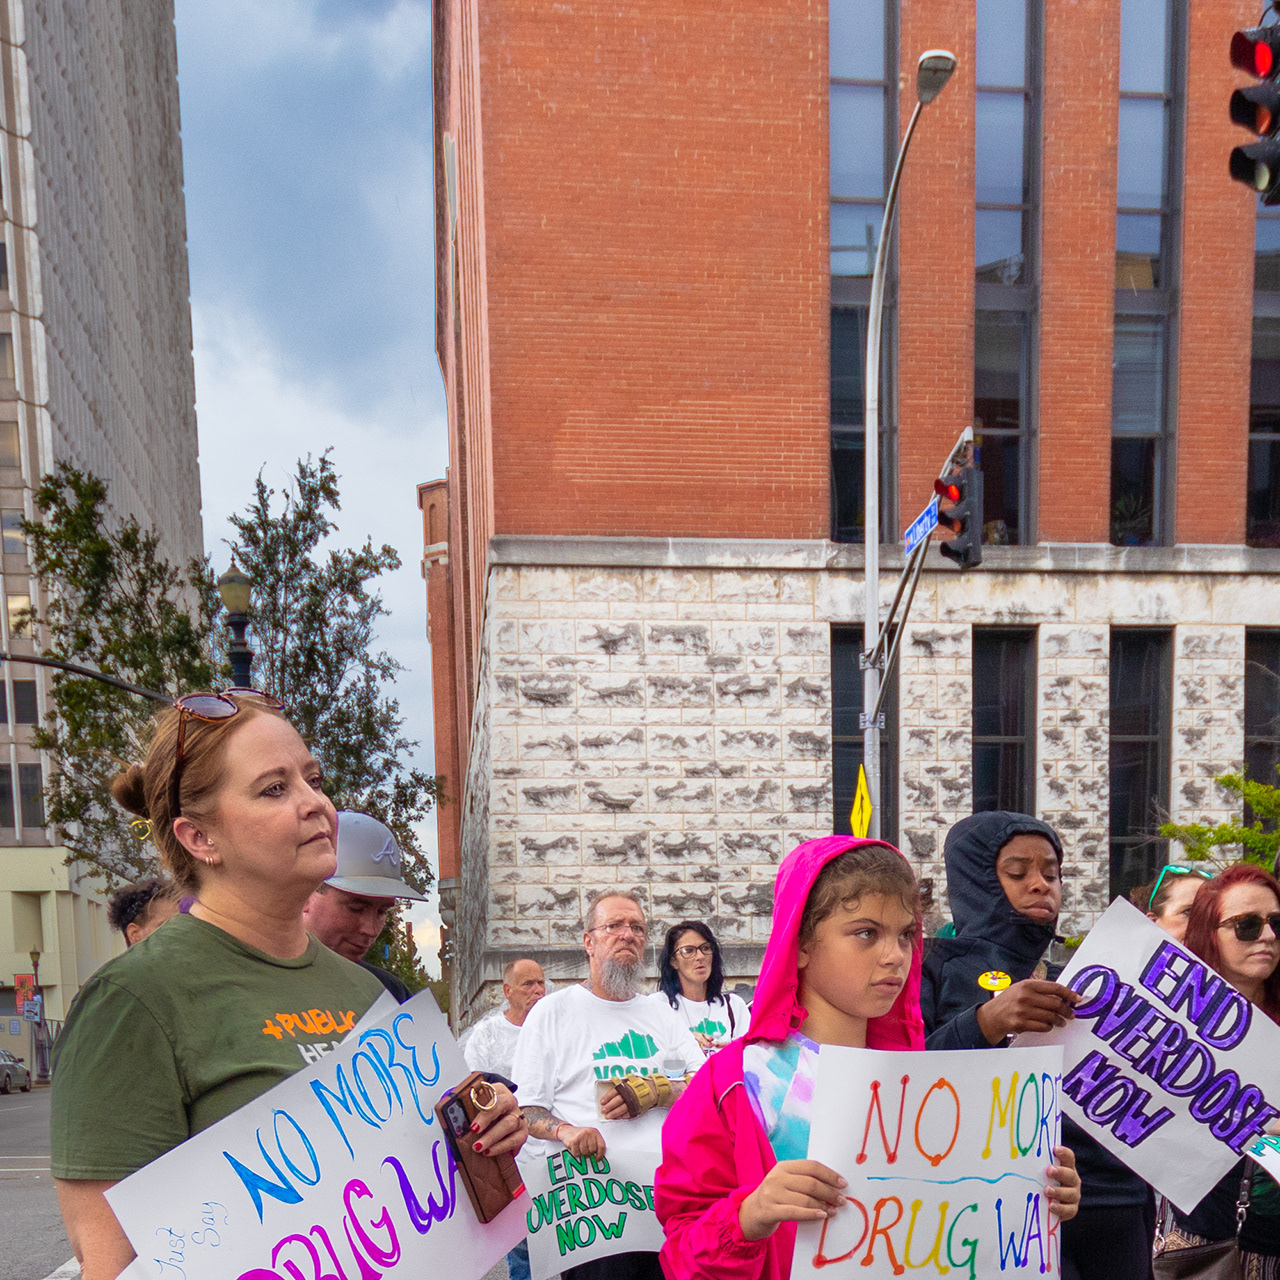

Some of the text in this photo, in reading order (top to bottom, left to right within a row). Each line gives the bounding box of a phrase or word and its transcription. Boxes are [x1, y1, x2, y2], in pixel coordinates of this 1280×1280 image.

[1138, 941, 1253, 1052] END
[223, 1012, 441, 1225] NO MORE
[855, 1074, 961, 1167] NO
[1062, 1050, 1176, 1149] NOW
[526, 1178, 656, 1233] OVERDOSE
[547, 1149, 611, 1185] END
[190, 1201, 229, 1248] Say
[556, 1212, 628, 1256] NOW
[995, 1192, 1062, 1277] WAR
